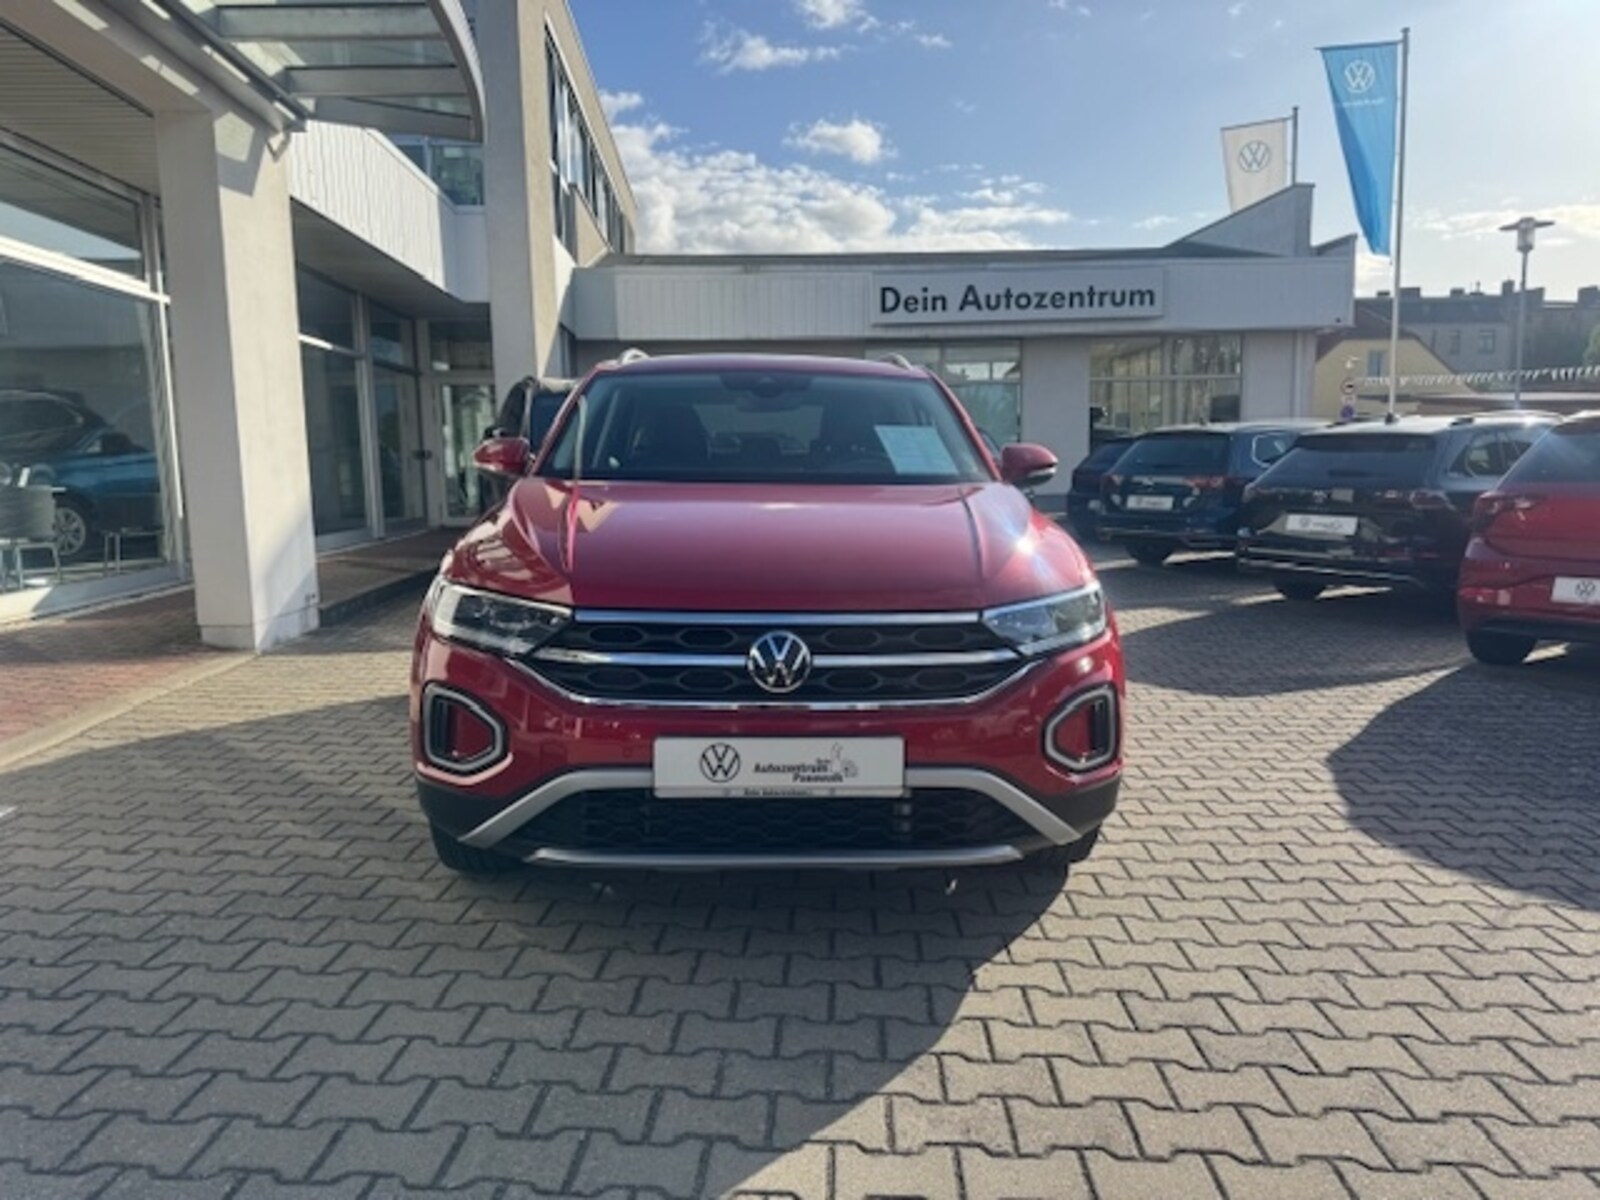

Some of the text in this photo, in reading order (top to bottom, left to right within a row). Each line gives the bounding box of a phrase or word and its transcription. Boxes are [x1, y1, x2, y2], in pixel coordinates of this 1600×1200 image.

[1344, 60, 1375, 93] VW
[1237, 141, 1271, 173] VW
[879, 284, 1156, 313] Dein Autozentrum
[748, 631, 811, 693] VW
[701, 743, 741, 782] VW
